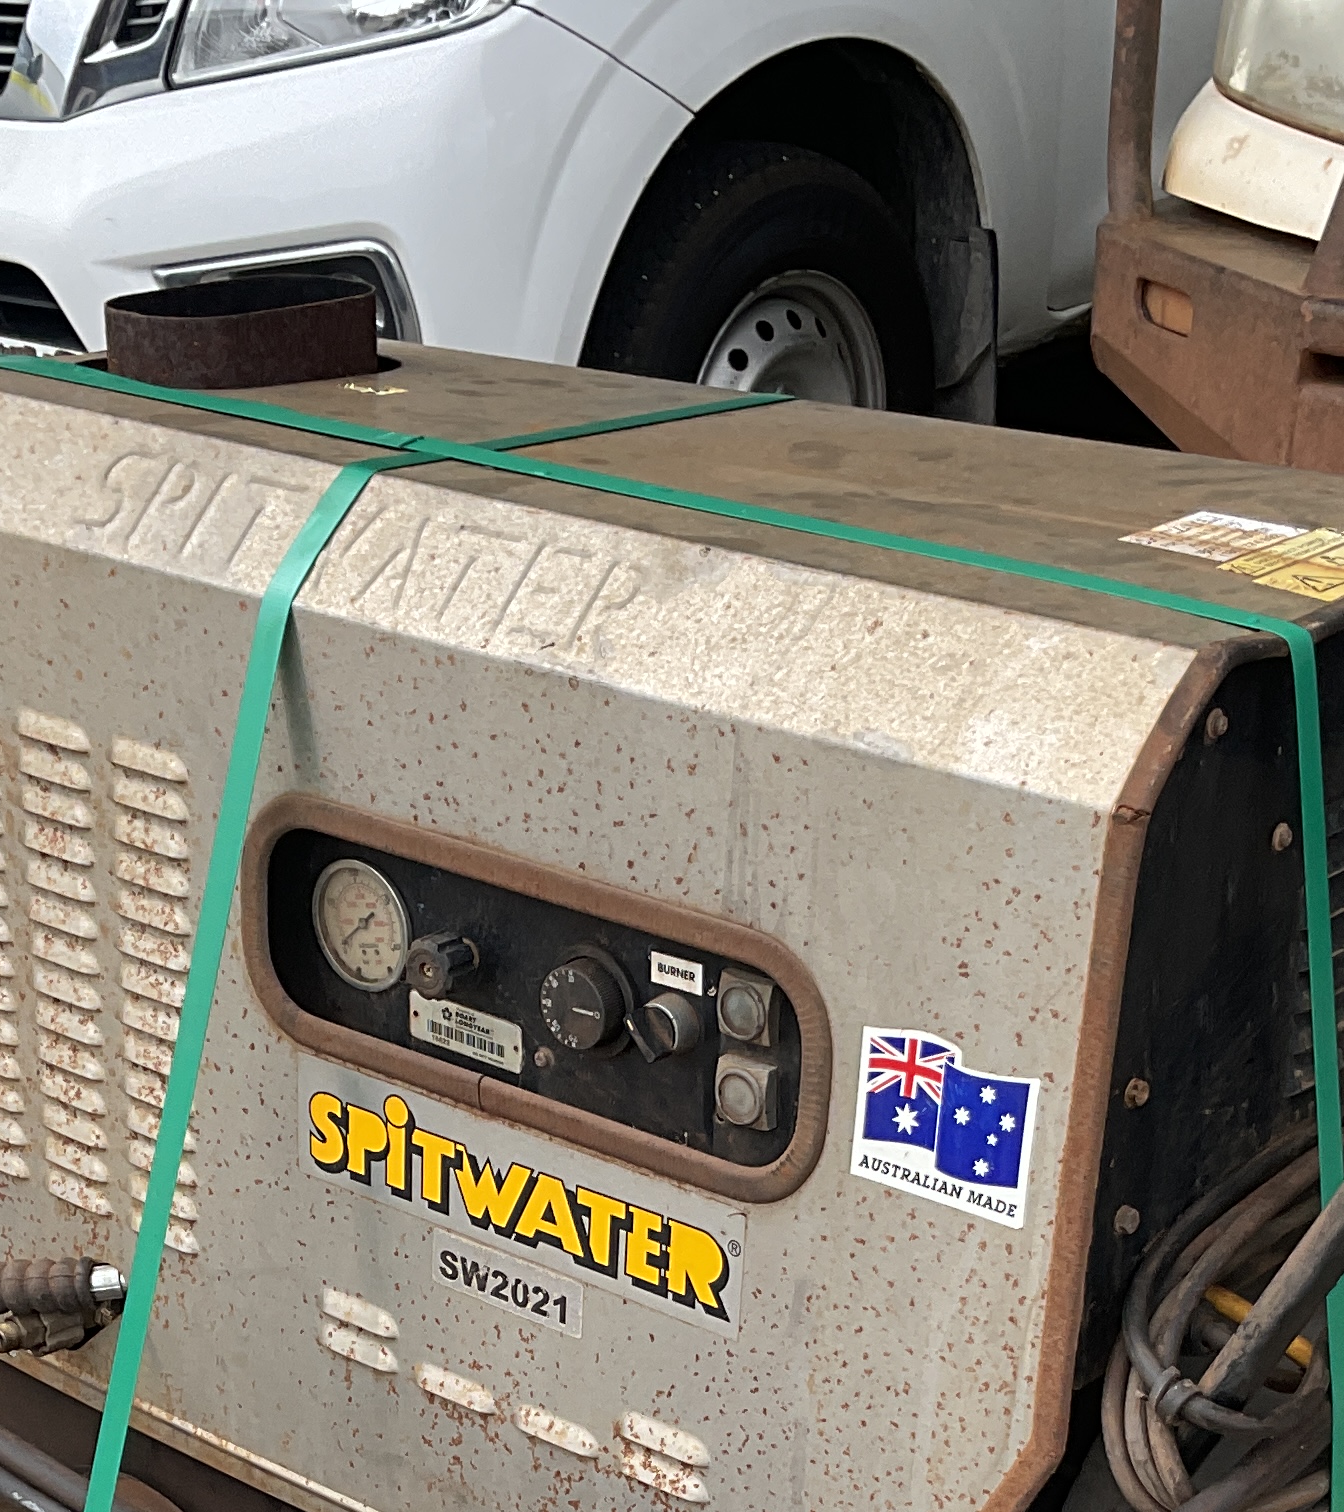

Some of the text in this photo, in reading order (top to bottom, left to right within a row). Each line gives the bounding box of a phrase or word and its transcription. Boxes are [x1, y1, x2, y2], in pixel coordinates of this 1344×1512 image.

[657, 961, 696, 983] BURNER
[857, 1154, 1018, 1219] AUSTRALIAN MADE
[439, 1248, 568, 1326] SW2021
